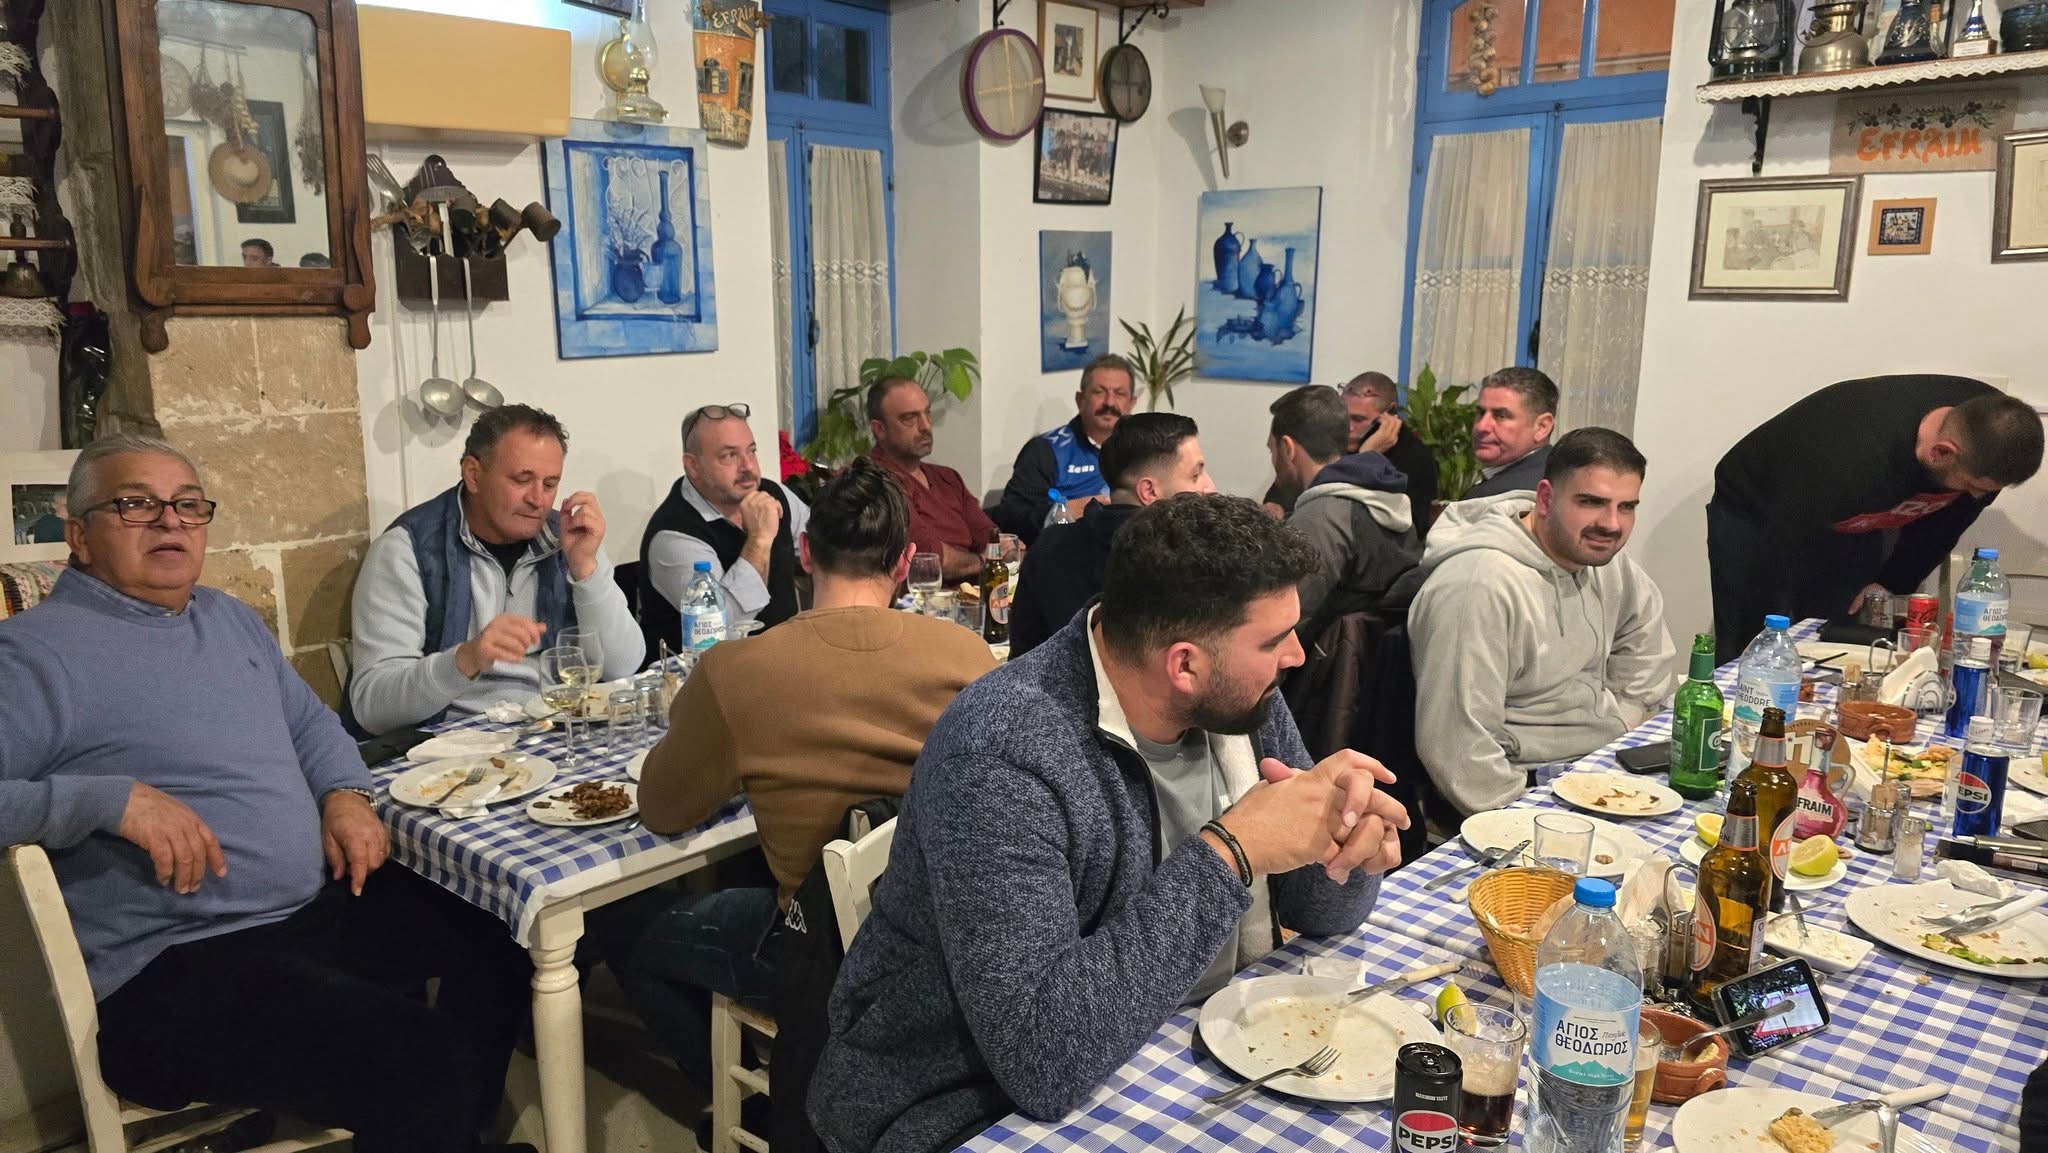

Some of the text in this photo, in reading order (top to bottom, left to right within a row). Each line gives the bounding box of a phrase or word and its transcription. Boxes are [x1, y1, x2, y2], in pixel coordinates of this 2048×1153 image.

[1856, 127, 1982, 164] EFRAIM
[1556, 1019, 1599, 1041] ΑΓΙΟΣ
[1555, 1033, 1628, 1056] ΘΕΟΔΩΡΟΣ
[1398, 1125, 1457, 1150] PEPSI
